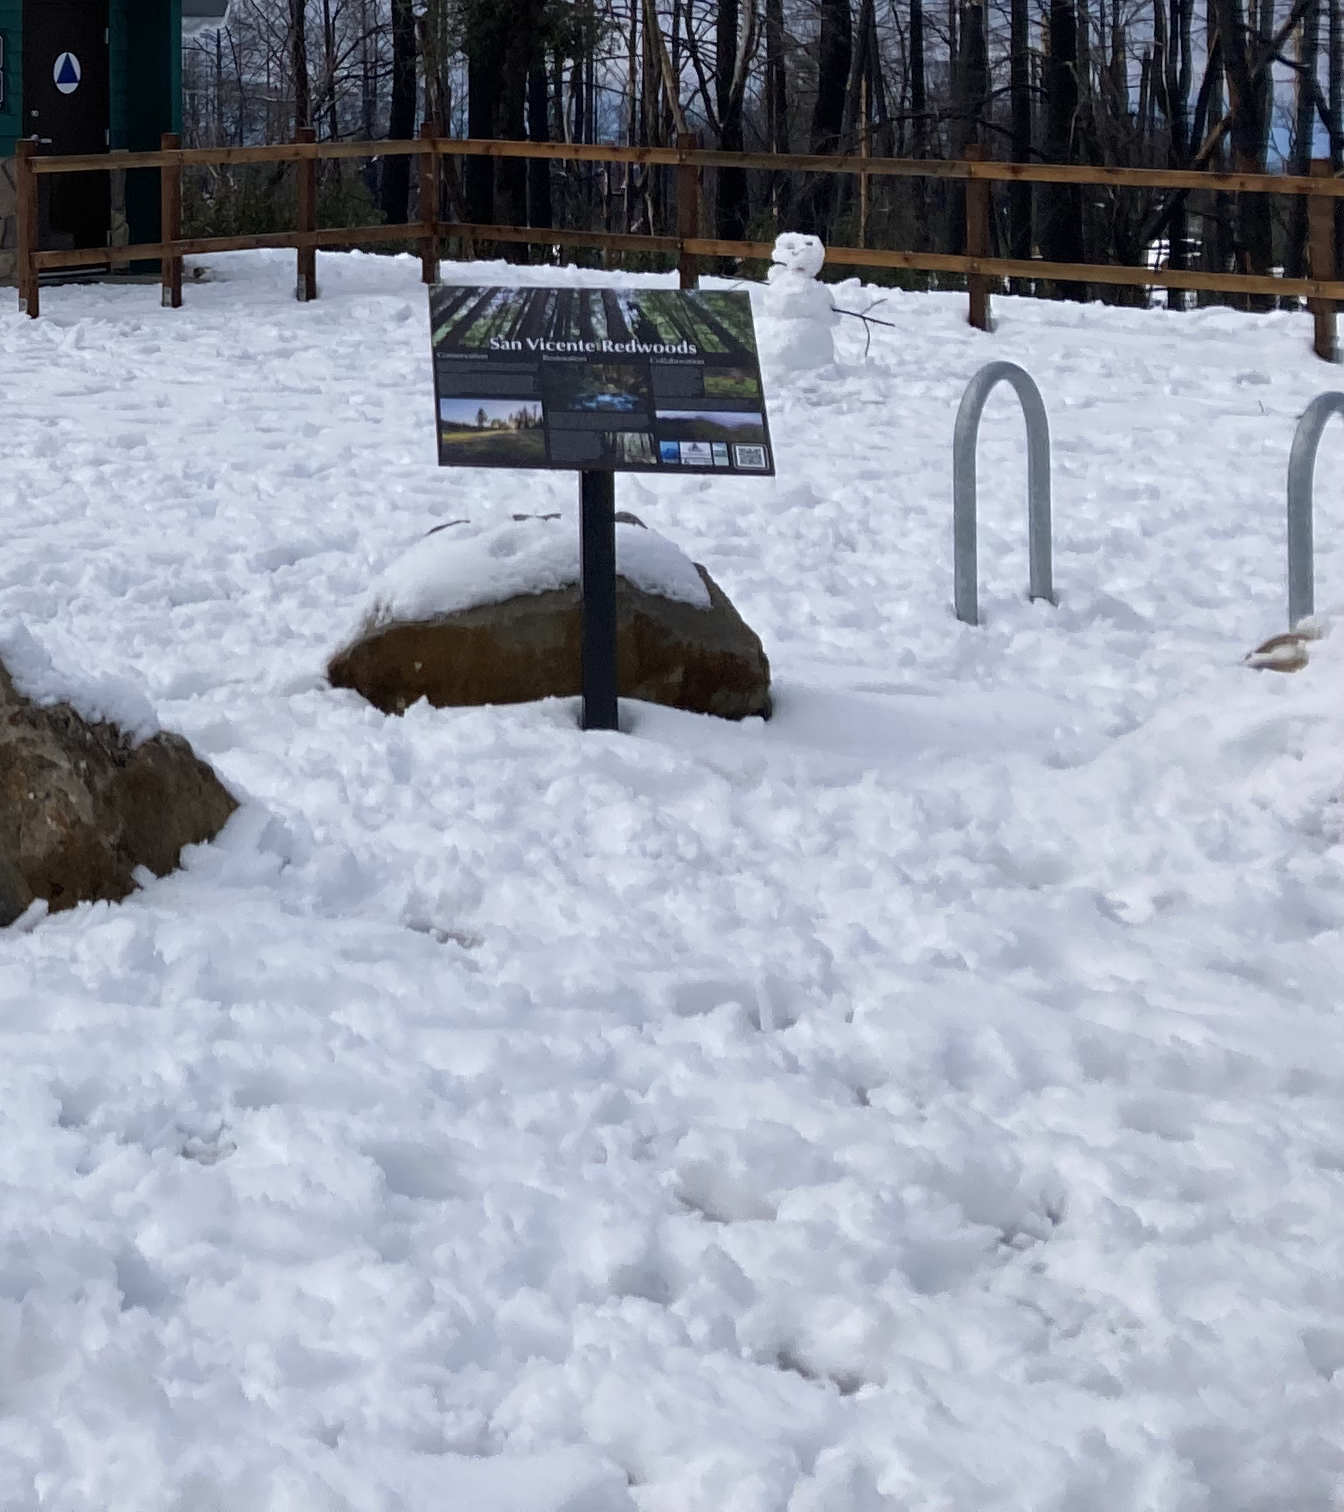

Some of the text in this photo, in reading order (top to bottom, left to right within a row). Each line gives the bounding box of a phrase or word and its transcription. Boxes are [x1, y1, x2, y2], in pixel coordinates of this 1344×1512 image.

[489, 336, 698, 355] San Vicente Redwoods
